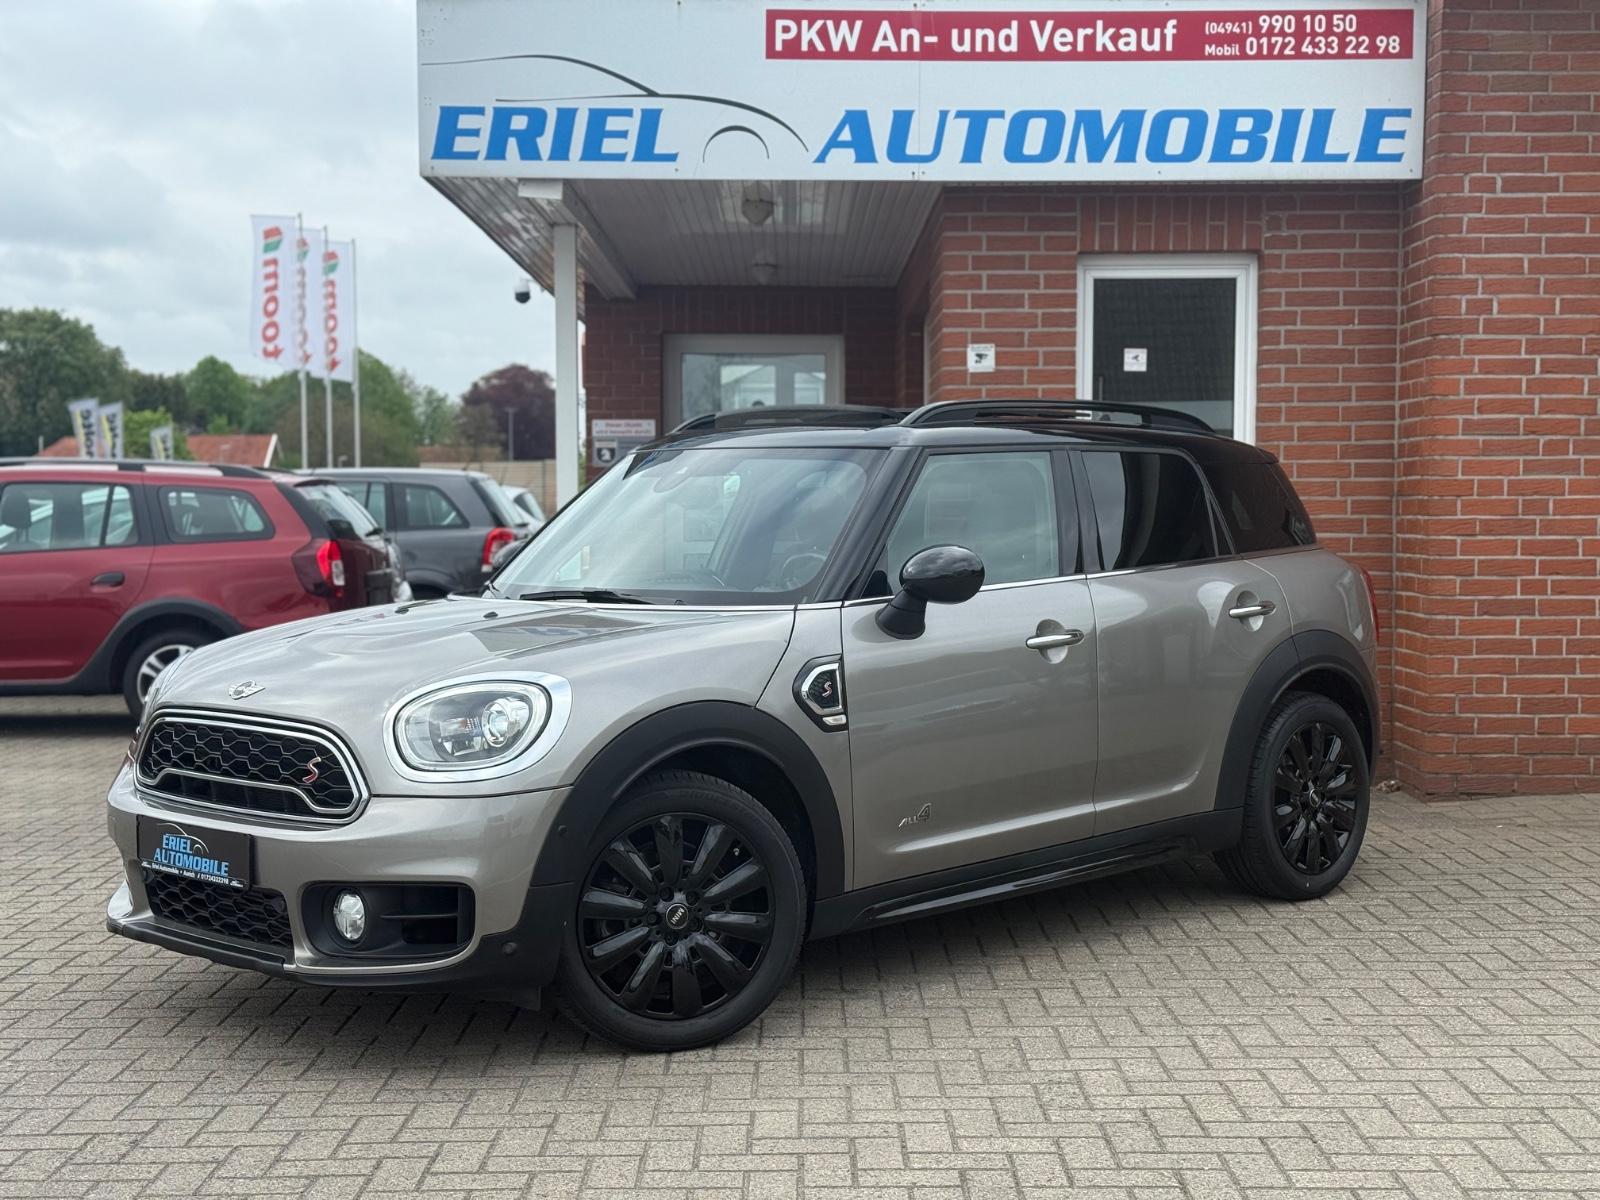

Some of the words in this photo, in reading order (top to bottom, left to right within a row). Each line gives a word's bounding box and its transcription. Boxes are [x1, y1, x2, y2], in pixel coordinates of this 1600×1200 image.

[1205, 21, 1253, 35] (04941)
[1259, 15, 1295, 33] 990
[1303, 15, 1326, 33] 10
[1333, 14, 1357, 33] 50
[774, 19, 863, 52] PKW
[872, 20, 938, 53] An-
[951, 19, 1019, 53] und
[1030, 19, 1177, 53] Verkauf
[1205, 44, 1240, 56] Mobil
[1245, 37, 1296, 55] 0172
[1301, 36, 1339, 55] 433
[1345, 36, 1370, 54] 22
[1376, 35, 1400, 54] 98
[431, 106, 679, 162] ERIEL
[812, 108, 1413, 164] AUTOMOBILE
[822, 681, 832, 698] S
[302, 756, 321, 783] S
[898, 803, 932, 827] ALL4
[162, 834, 192, 854] ERIEL
[153, 847, 229, 876] AUTOMOBILE
[670, 907, 685, 925] MINI
